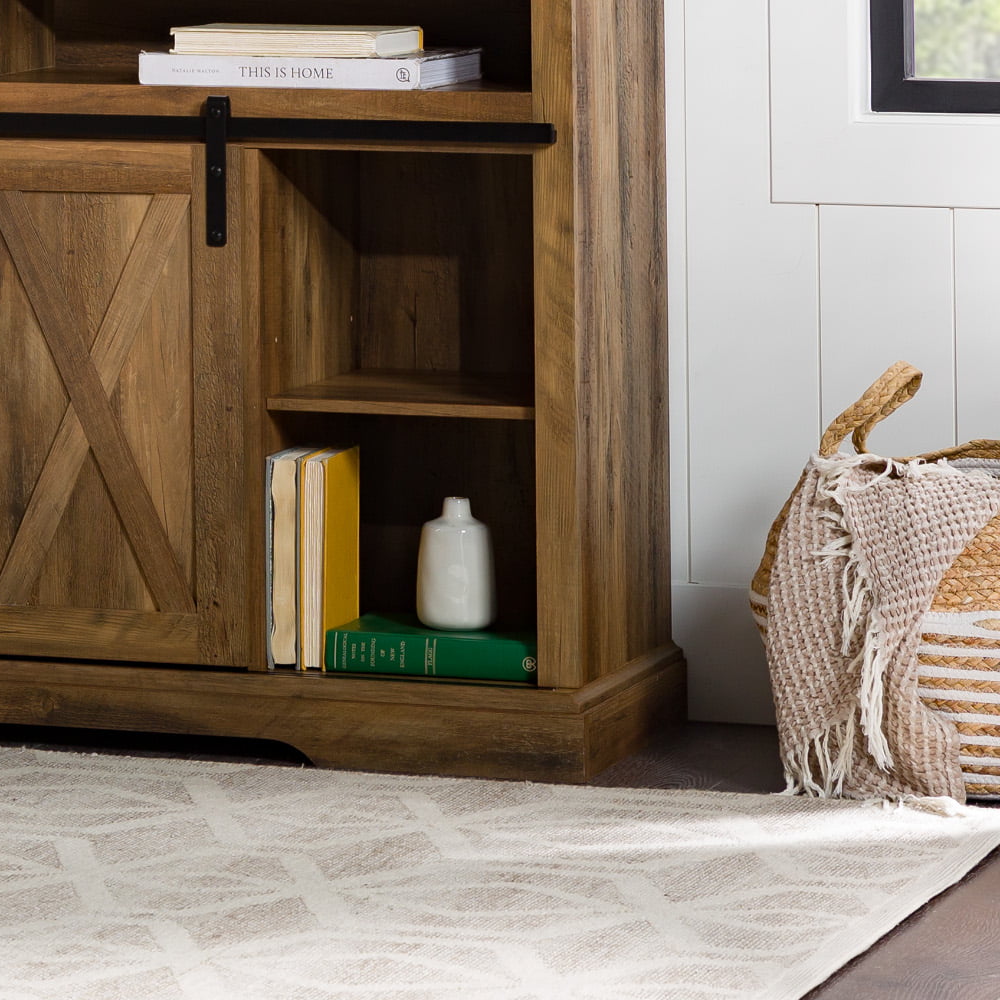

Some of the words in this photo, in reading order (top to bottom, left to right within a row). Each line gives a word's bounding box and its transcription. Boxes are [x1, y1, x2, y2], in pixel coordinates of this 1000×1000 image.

[238, 66, 271, 78] THIS
[275, 67, 287, 78] IS
[291, 67, 334, 79] HOME
